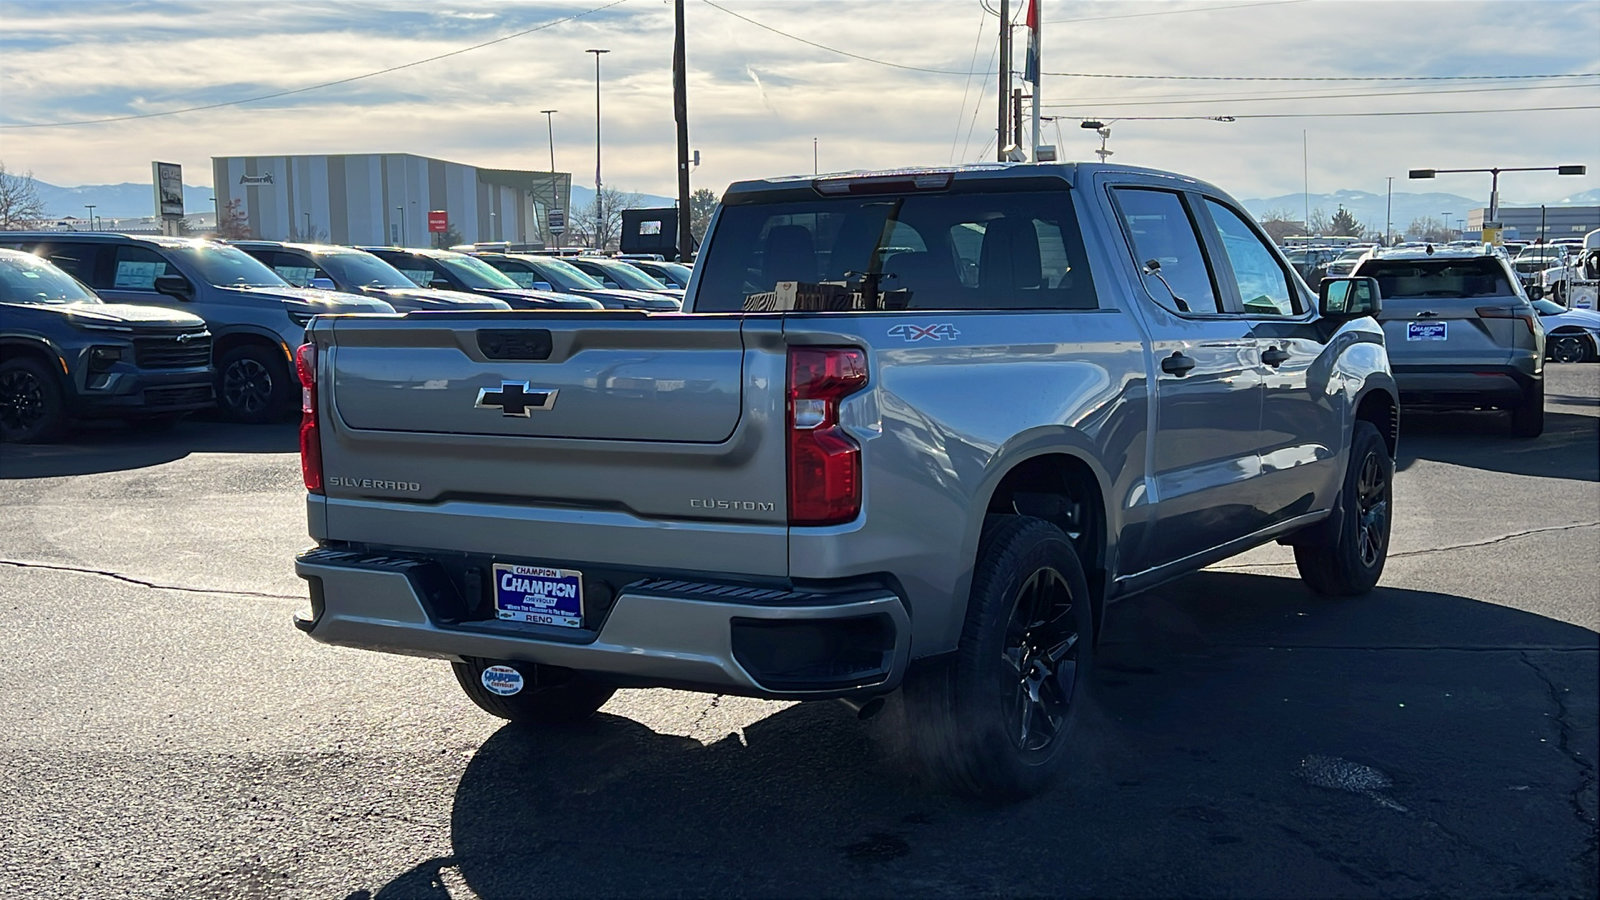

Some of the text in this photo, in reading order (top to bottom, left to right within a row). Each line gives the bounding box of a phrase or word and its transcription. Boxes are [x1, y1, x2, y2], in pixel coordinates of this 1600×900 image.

[329, 477, 420, 491] SILVERADO
[690, 498, 775, 511] CUSTOM
[516, 566, 557, 577] CHAMPION
[501, 573, 576, 598] CHAMPION
[526, 614, 553, 624] RENO
